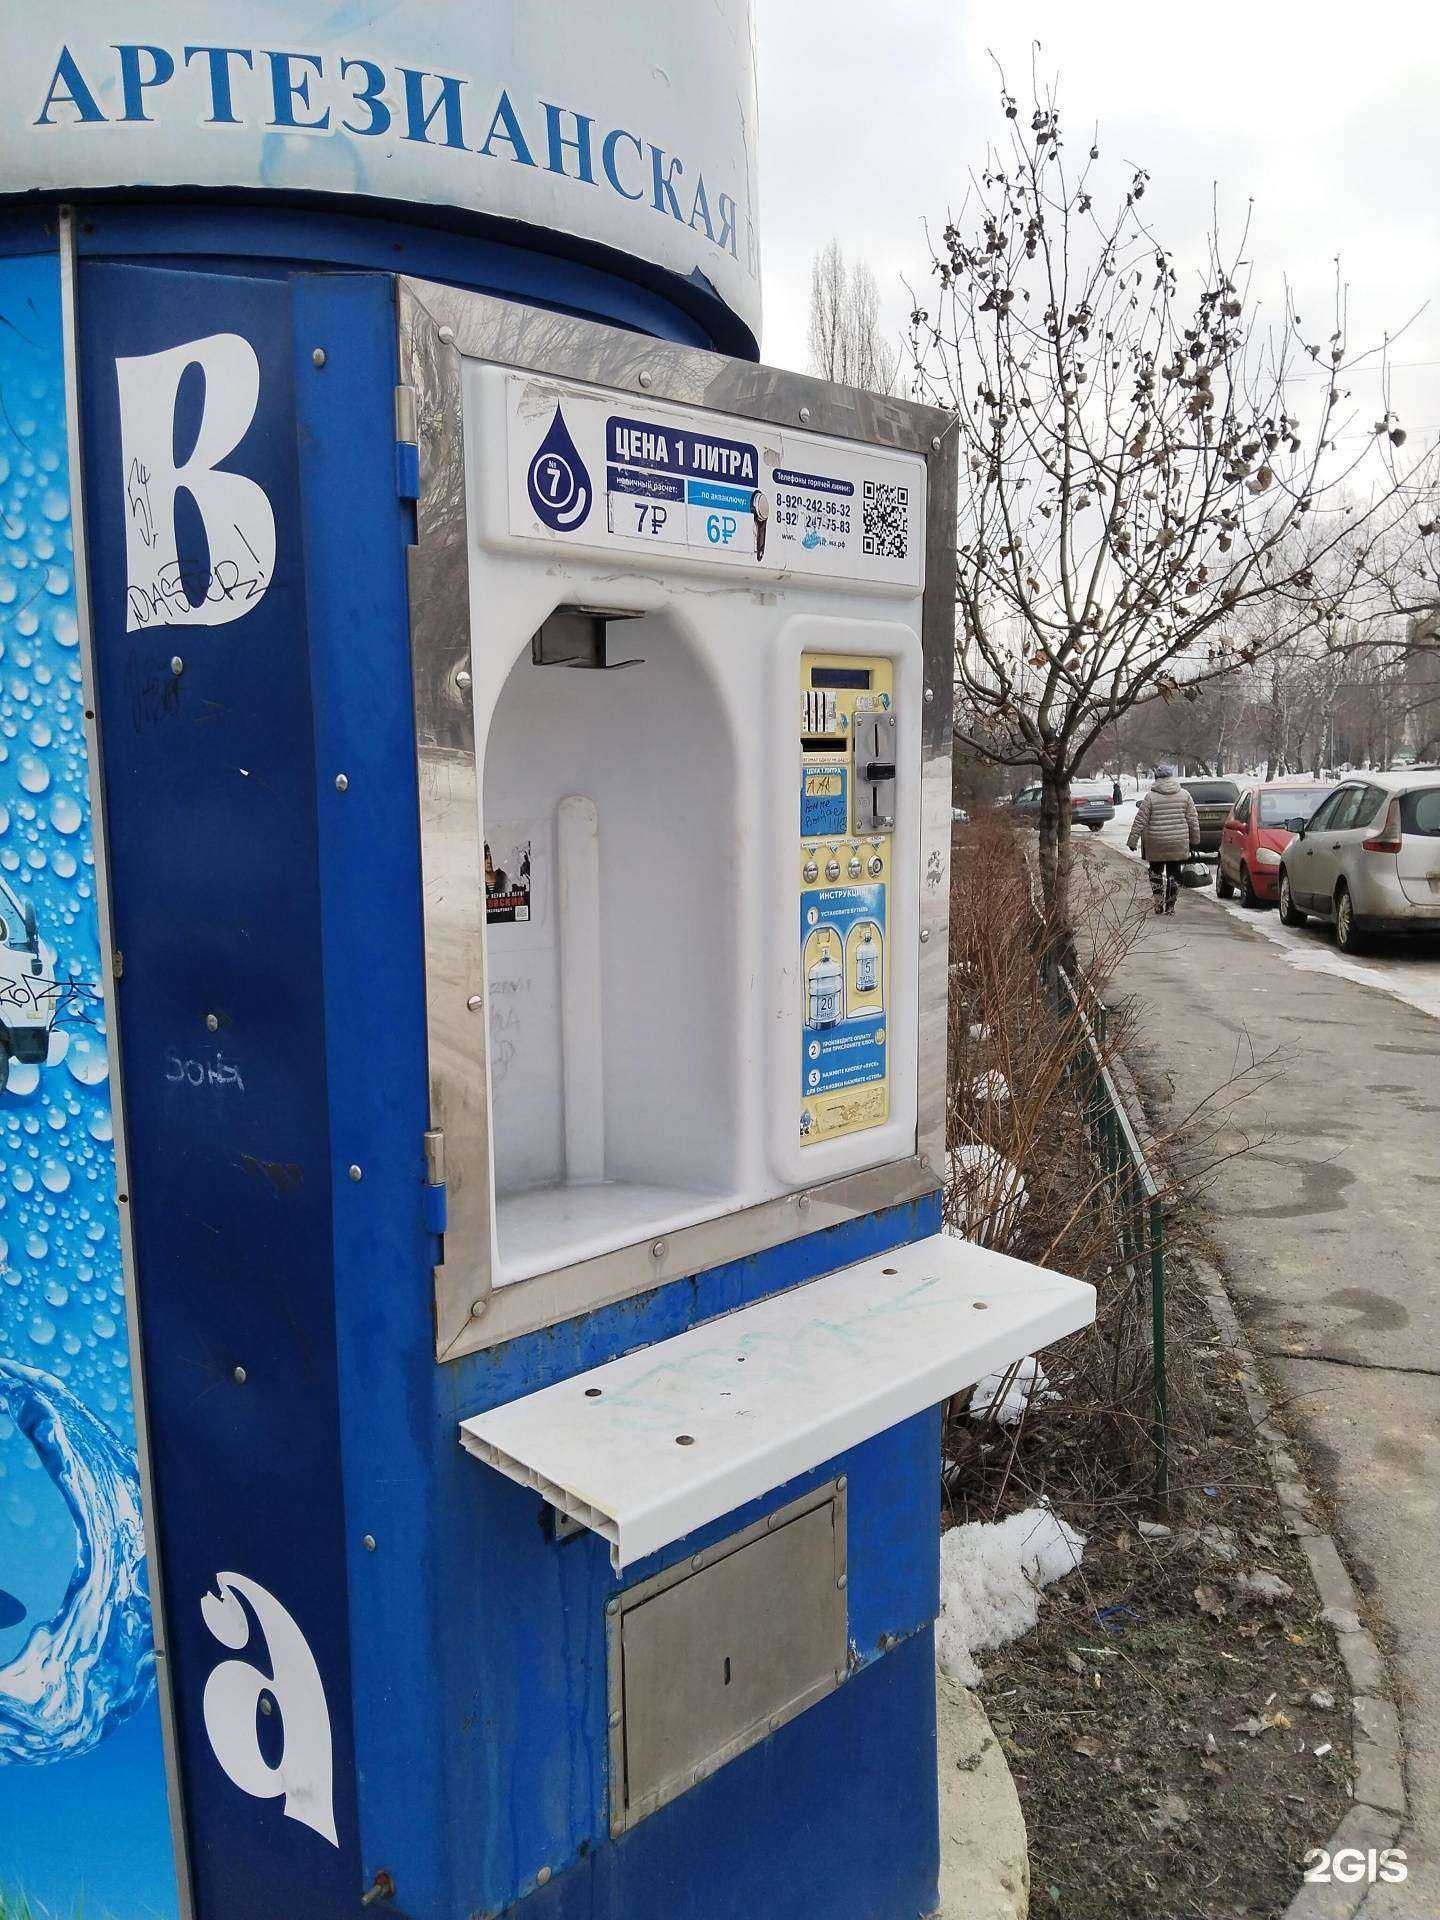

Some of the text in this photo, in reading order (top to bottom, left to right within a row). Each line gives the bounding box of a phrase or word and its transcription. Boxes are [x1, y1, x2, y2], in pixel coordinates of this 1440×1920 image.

[33, 44, 739, 261] АРТЕЗИАНСКАЯ
[615, 427, 754, 479] ЦЕНА 1 ЛИТРА
[547, 468, 560, 497] 7
[776, 471, 807, 485] Телефоны
[807, 479, 831, 490] горячей
[701, 491, 710, 500] по
[776, 492, 851, 518] 8-920-242-56-32
[865, 961, 871, 974] 5
[820, 997, 833, 1011] 20
[810, 1045, 817, 1056] 2
[811, 1072, 817, 1083] 3
